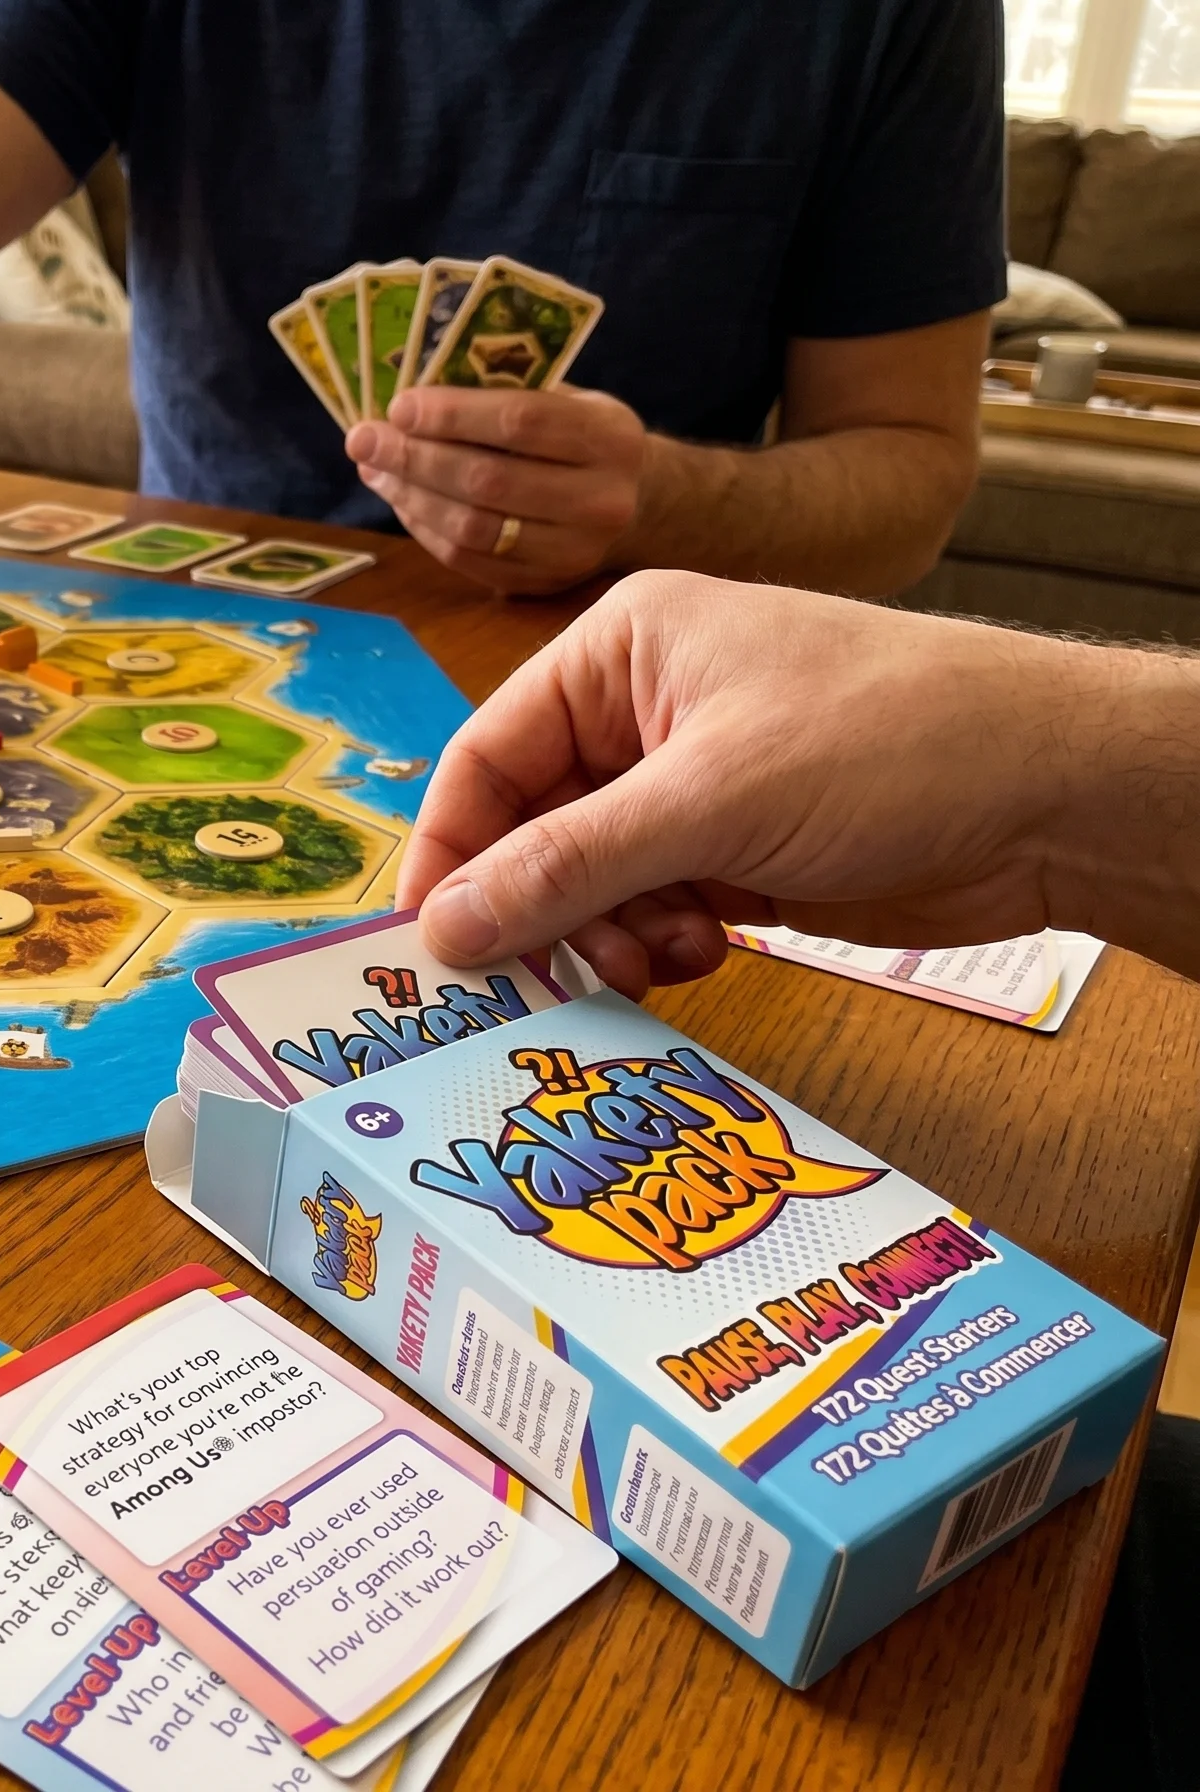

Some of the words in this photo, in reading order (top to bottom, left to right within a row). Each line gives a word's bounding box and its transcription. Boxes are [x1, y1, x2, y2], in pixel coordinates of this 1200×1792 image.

[354, 1111, 391, 1131] 6+
[410, 1048, 766, 1235] Yakety
[408, 1232, 441, 1302] PACK
[396, 1291, 430, 1375] YAKETY
[756, 1279, 884, 1355] PLAY,
[68, 1393, 142, 1436] What's
[140, 1367, 186, 1401] your
[184, 1349, 220, 1374] top
[811, 1389, 866, 1427] 172
[853, 1351, 937, 1402] Quest
[922, 1305, 1018, 1363] Starters
[814, 1445, 871, 1484] 172
[960, 1313, 1093, 1395] Commencer
[62, 1420, 145, 1476] strategy
[144, 1404, 176, 1430] for
[178, 1348, 280, 1409] convincing
[84, 1437, 180, 1498] everyone
[176, 1408, 240, 1447] you're
[240, 1380, 275, 1407] not
[109, 1463, 194, 1520] Among
[232, 1381, 327, 1442] impostor?
[227, 1551, 289, 1596] Have
[286, 1526, 328, 1562] you
[327, 1496, 376, 1530] ever
[370, 1462, 419, 1501] used
[373, 1488, 444, 1539] outside
[158, 1519, 250, 1596] Level
[308, 1631, 365, 1674] How
[365, 1599, 404, 1636] did
[395, 1590, 421, 1609] it
[416, 1555, 470, 1594] work
[468, 1521, 510, 1560] out?
[331, 1586, 356, 1612] of
[355, 1530, 438, 1599] gaming?
[22, 1652, 122, 1747] Level
[106, 1674, 169, 1727] Who
[149, 1702, 195, 1752] and
